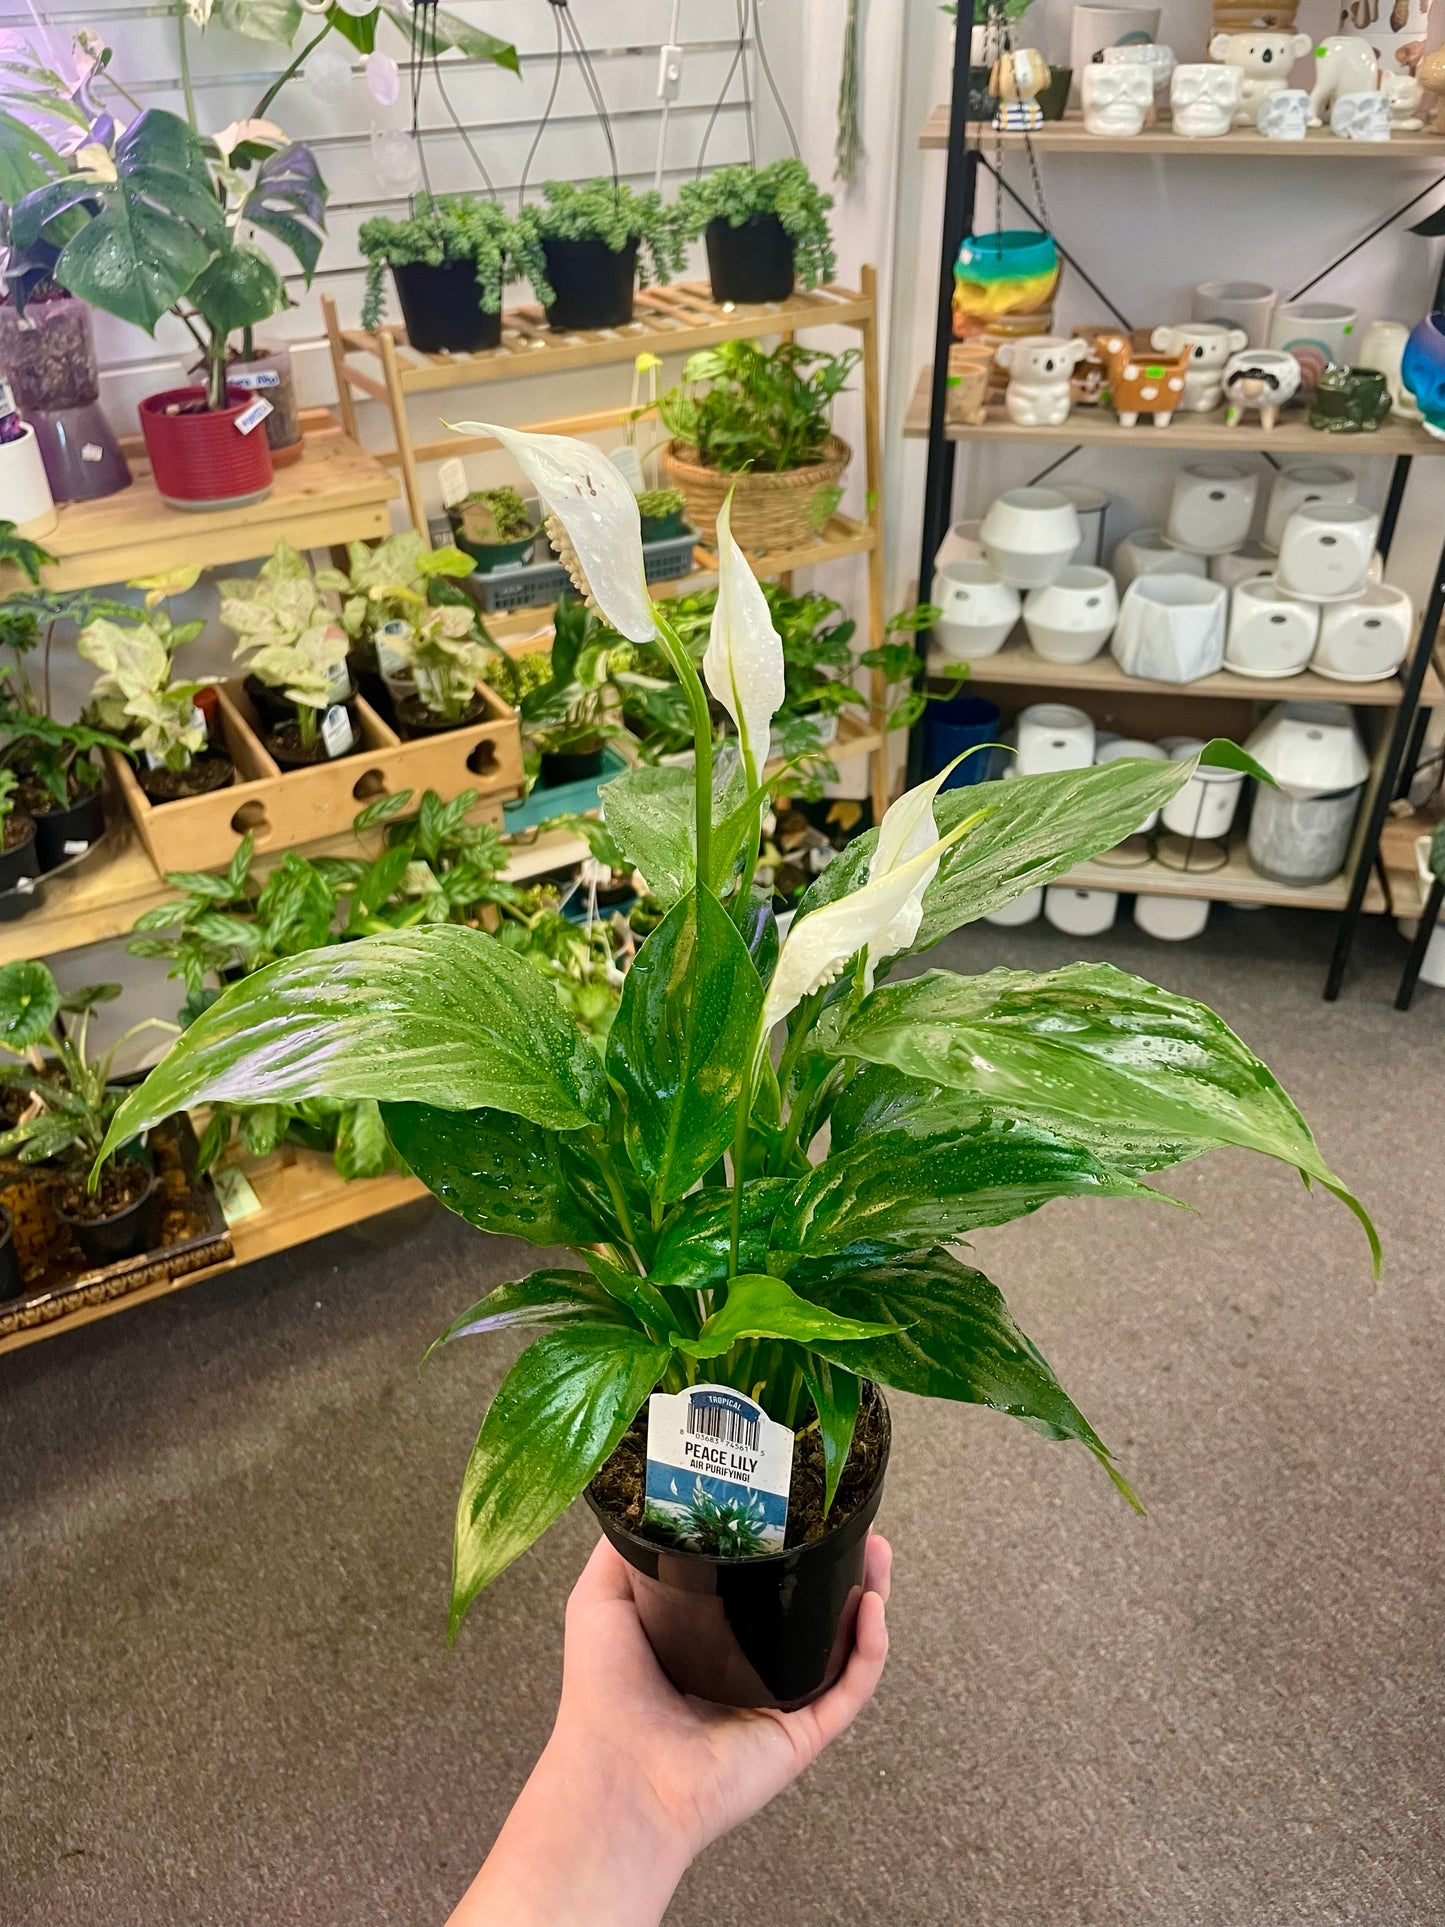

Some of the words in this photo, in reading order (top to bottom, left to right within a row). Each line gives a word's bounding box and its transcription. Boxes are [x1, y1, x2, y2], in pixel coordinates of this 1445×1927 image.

[708, 1395, 742, 1411] TROPICAL
[695, 1433, 719, 1445] 03683
[725, 1440, 748, 1452] 74561
[685, 1441, 728, 1466] PEACE
[731, 1453, 758, 1474] LILY
[690, 1459, 704, 1470] AIR
[706, 1463, 750, 1483] PURIFYING!
